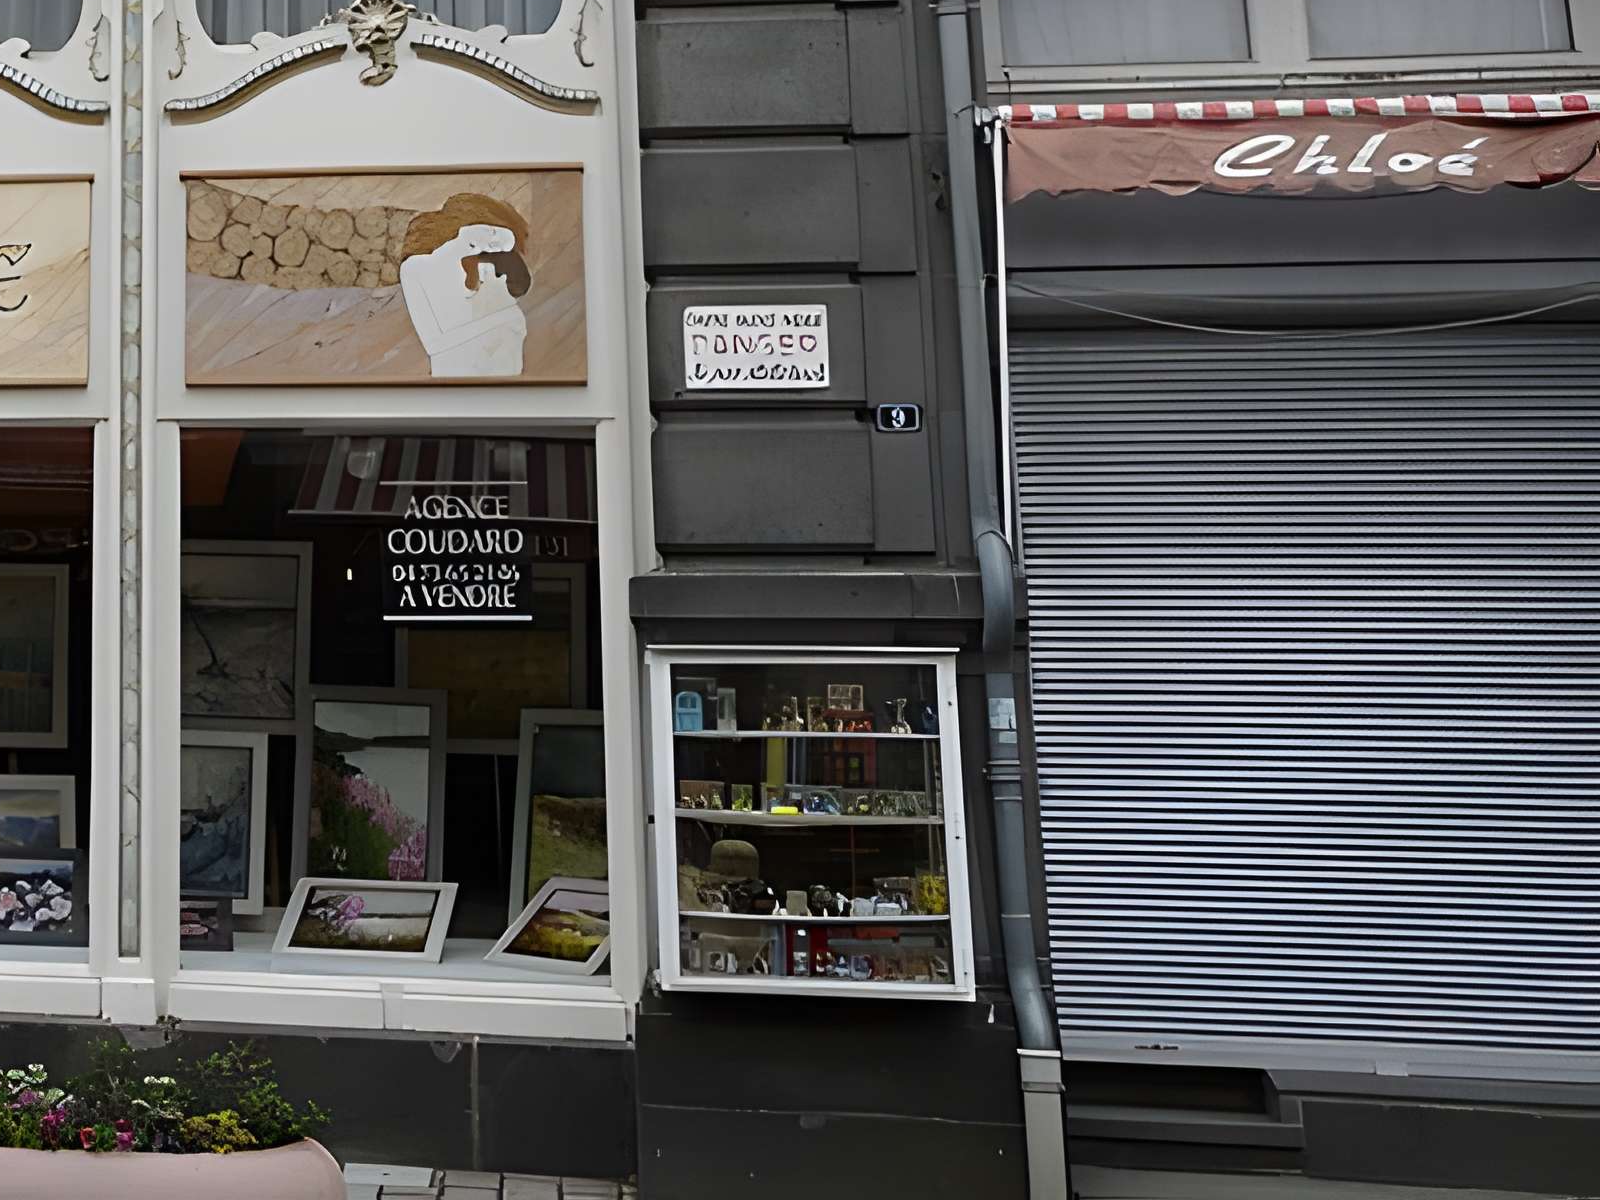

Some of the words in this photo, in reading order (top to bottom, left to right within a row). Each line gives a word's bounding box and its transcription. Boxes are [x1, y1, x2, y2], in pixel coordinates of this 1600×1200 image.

[1213, 131, 1489, 178] Chloé
[890, 407, 906, 429] 9
[404, 495, 509, 519] AGENCE
[400, 585, 416, 607] A
